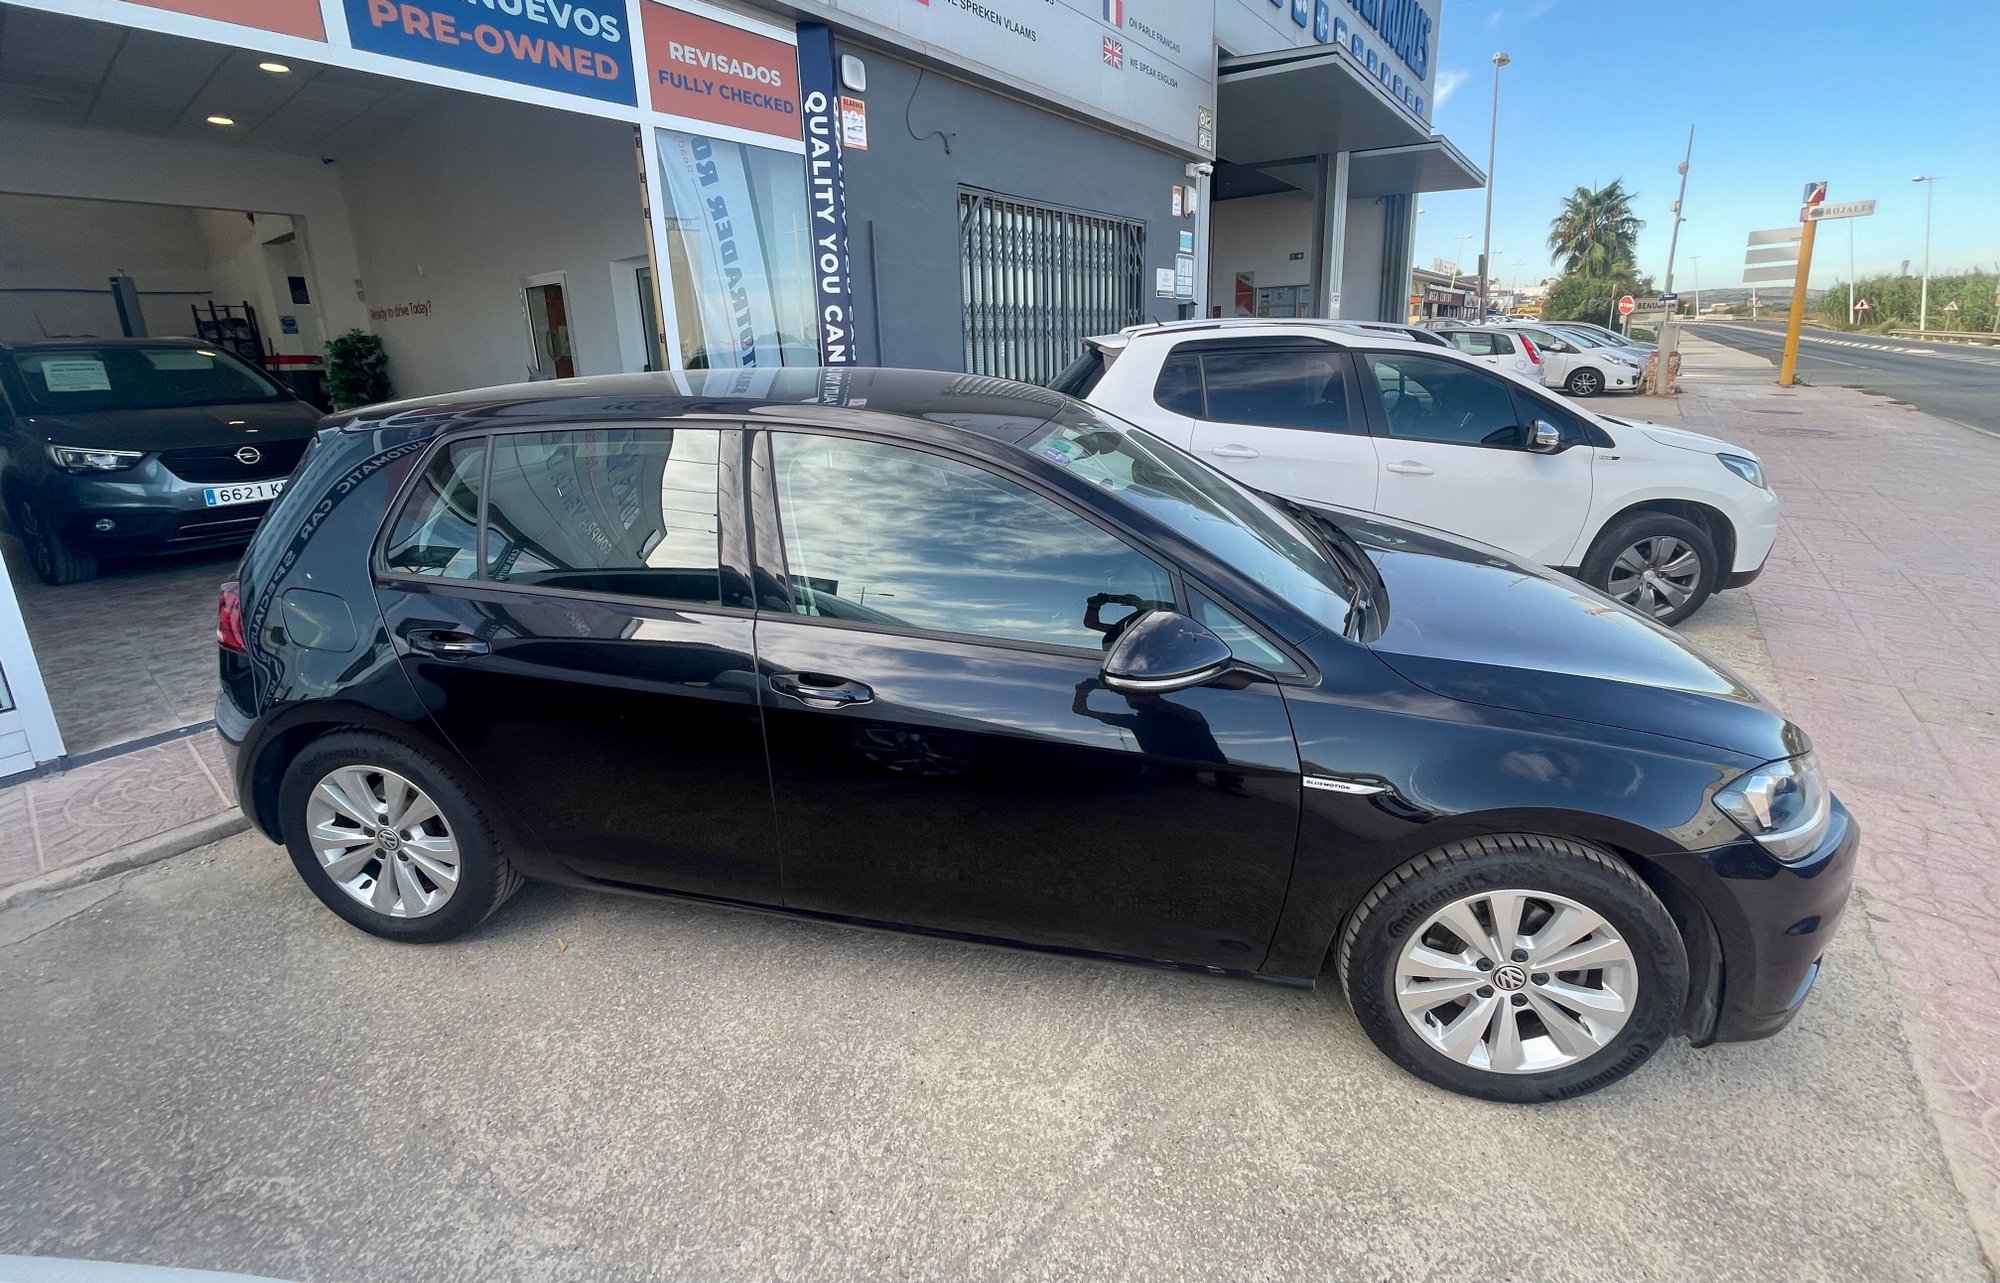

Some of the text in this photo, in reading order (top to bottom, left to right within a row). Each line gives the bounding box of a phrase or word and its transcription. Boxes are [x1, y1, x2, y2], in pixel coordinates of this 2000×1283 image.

[367, 0, 620, 81] PRE-OWNED
[460, 0, 621, 43] UEVOS
[960, 0, 1002, 26] SPREKEN
[1003, 16, 1037, 42] VLAAMS
[1128, 17, 1138, 29] ON
[1139, 22, 1156, 40] PARLE
[668, 41, 782, 87] REVISADOS
[1128, 57, 1178, 89] WE SPEAK ENGLISH
[658, 69, 794, 114] FULLY CHECKED
[804, 91, 836, 224] QUALITY
[1825, 203, 1873, 216] ROJALES
[818, 233, 841, 294] YOU
[824, 304, 847, 363] CAN
[220, 485, 263, 502] 6621
[1306, 779, 1351, 790] BLUEMOTION
